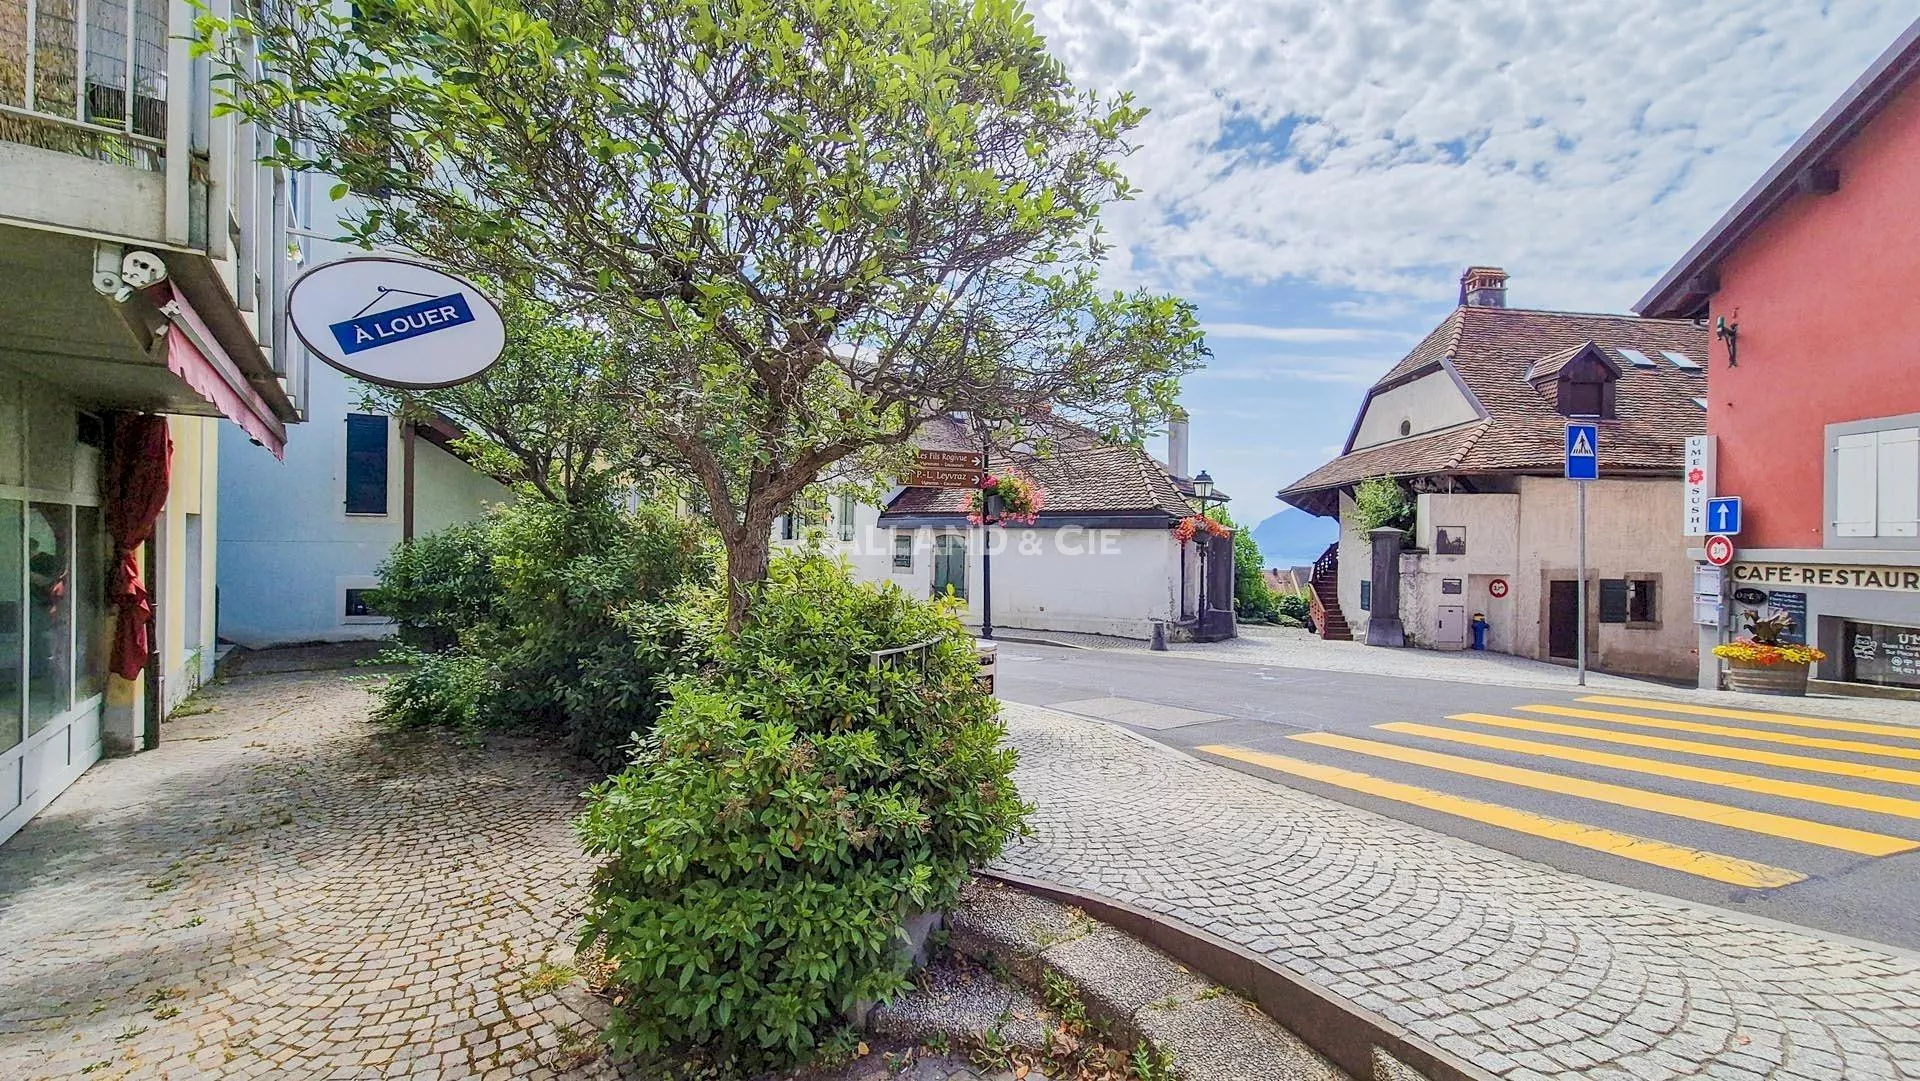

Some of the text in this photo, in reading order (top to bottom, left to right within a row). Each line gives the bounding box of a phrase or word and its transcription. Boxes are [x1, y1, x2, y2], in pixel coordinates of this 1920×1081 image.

[354, 305, 460, 344] À LOUER
[929, 452, 940, 460] Fils
[942, 453, 968, 463] Rogivue
[936, 471, 967, 481] Leyvraz
[1690, 439, 1702, 533] UME SUSHI
